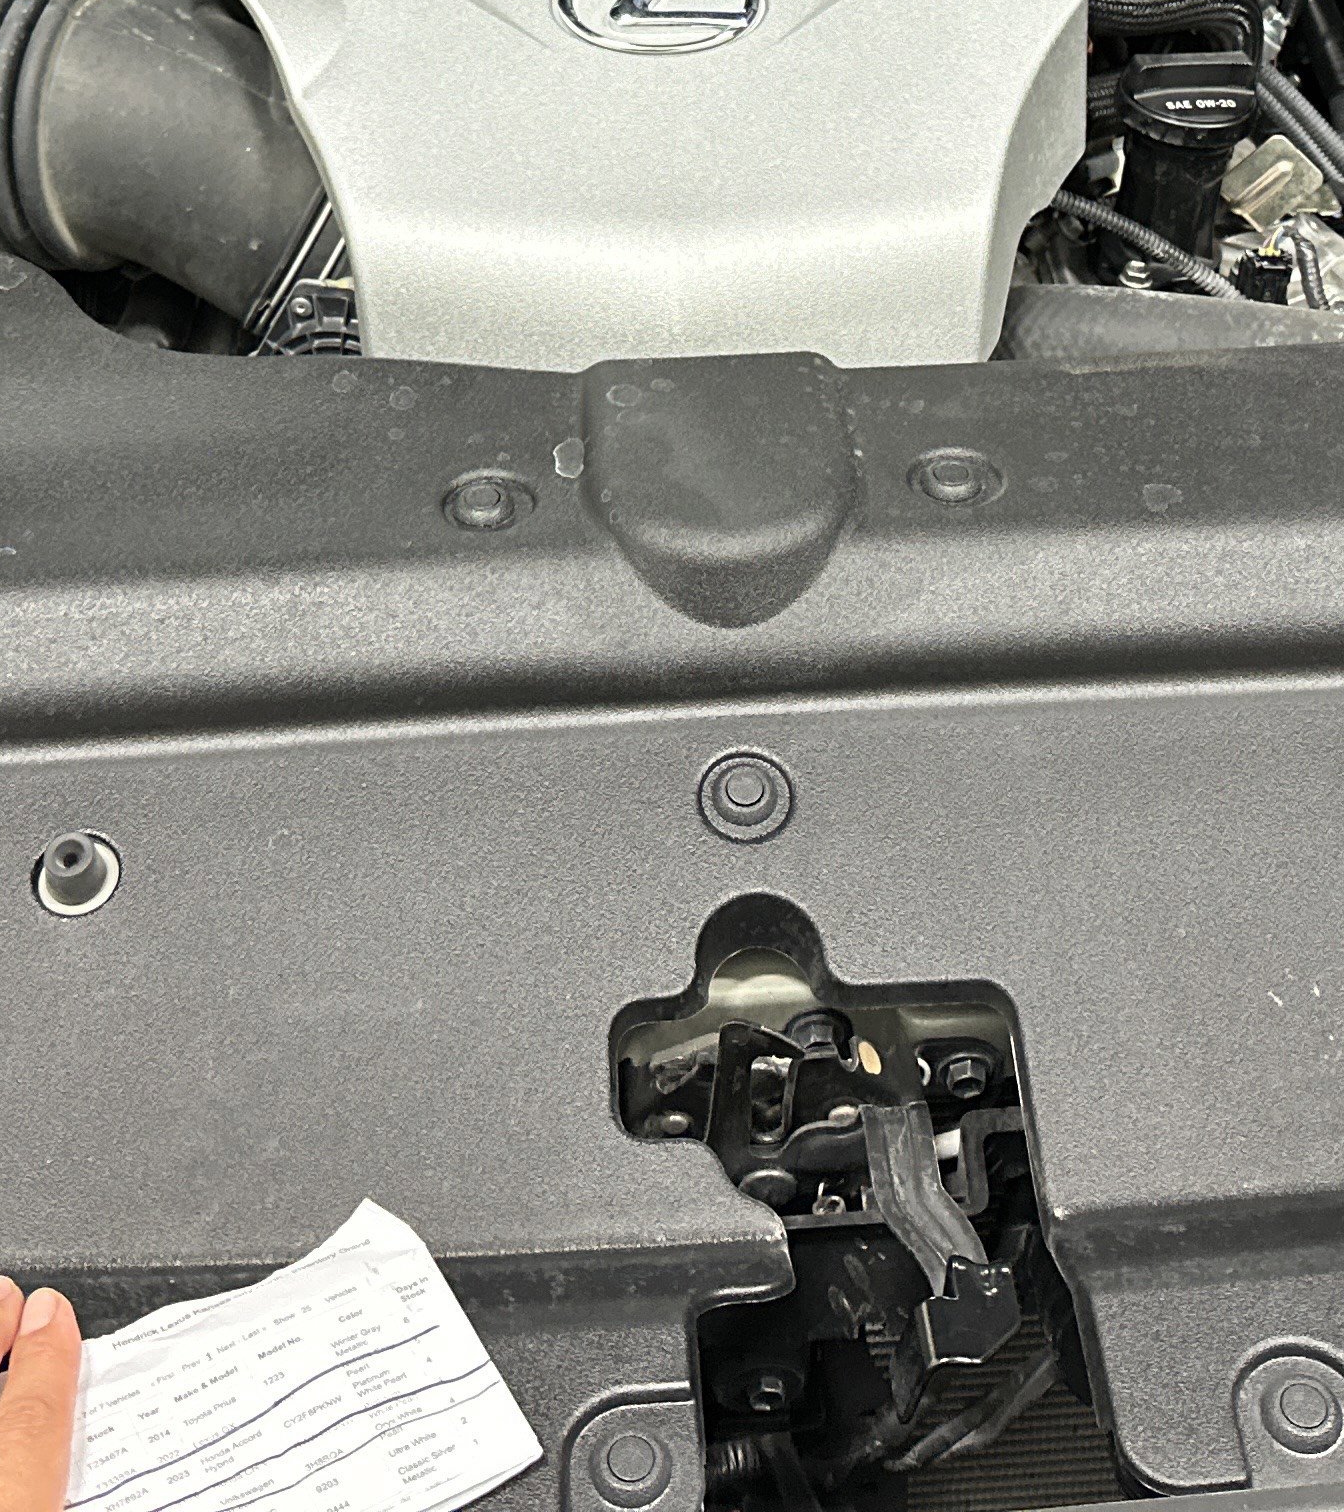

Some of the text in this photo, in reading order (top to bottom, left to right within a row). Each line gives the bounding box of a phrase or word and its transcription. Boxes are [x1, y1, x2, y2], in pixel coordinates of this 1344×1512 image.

[1165, 99, 1237, 110] SAE 0W-20
[396, 1281, 419, 1294] Days
[400, 1288, 426, 1303] Stock
[105, 1389, 141, 1408] Vehicles
[273, 1313, 296, 1326] Show
[301, 1305, 313, 1314] 25
[324, 1286, 358, 1303] Vehicles
[112, 1329, 159, 1350] Hendrick
[160, 1313, 191, 1332] Lexus
[87, 1426, 115, 1443] Stock
[137, 1407, 160, 1420] Year
[174, 1388, 199, 1403] Make
[209, 1365, 238, 1385] Model
[257, 1342, 287, 1360] Model
[338, 1308, 363, 1323] Color
[148, 1429, 171, 1444] 2014
[183, 1409, 213, 1427] Toyota
[213, 1396, 237, 1411] Prius
[330, 1333, 358, 1349] Winter
[360, 1324, 381, 1337] Gray
[383, 1372, 408, 1386] Pearl
[388, 1444, 411, 1458] Ultra
[411, 1432, 437, 1447] White
[460, 1416, 468, 1425] 2
[166, 1469, 191, 1485] 2023
[200, 1447, 231, 1465] Honda
[232, 1429, 263, 1450] Accord
[397, 1456, 430, 1476] Classic
[431, 1444, 456, 1459] Silver
[220, 1478, 275, 1505] Volkswagen
